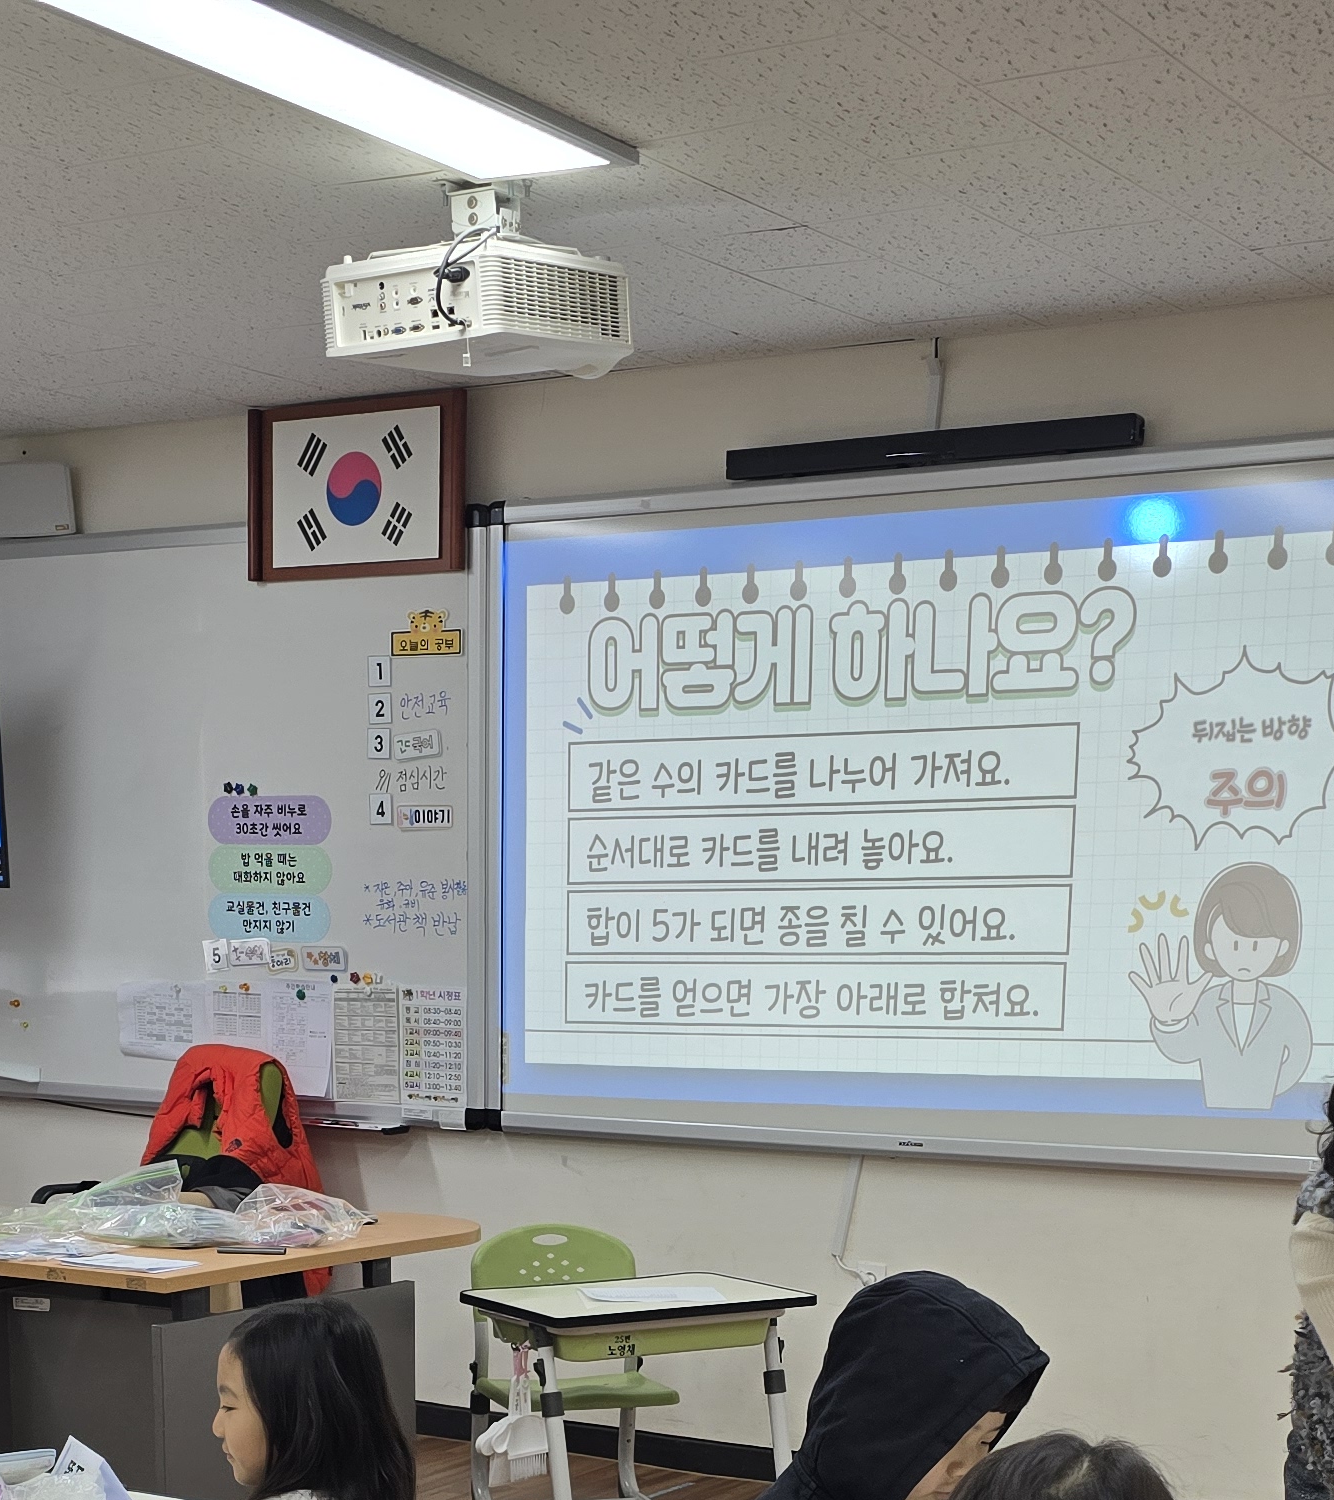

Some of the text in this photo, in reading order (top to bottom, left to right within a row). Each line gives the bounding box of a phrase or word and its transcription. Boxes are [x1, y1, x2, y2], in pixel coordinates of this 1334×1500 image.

[399, 638, 454, 651] 오늘의 공부
[588, 586, 1137, 718] 어떻게 하나요?
[376, 663, 382, 680] 1
[375, 700, 385, 718] 2
[400, 691, 451, 720] 안전교육
[1192, 714, 1312, 743] 뒤집는 방향
[374, 735, 384, 752] 3
[396, 765, 447, 792] 점심시간
[588, 750, 1010, 803] 같은 수의 카드를 나누어 가져요.
[1204, 767, 1287, 818] 주의
[230, 804, 307, 818] 손을 자주 비누로
[376, 801, 385, 818] 4
[414, 808, 450, 824] 이야기
[235, 822, 302, 837] 30초간 씻어요
[587, 828, 953, 872] 순서대로 카드를 내려 놓아요.
[241, 852, 297, 867] 밥 먹을 때는
[233, 871, 306, 886] 대화하지 않아요
[226, 901, 311, 916] 교실물건, 친구물건
[242, 920, 295, 934] 만지지 않기
[413, 912, 427, 937] 책
[431, 911, 461, 936] 반납
[587, 903, 1015, 948] 합이 5가 되면 종을 칠 수 있어요.
[212, 947, 221, 963] 5
[415, 990, 461, 1001] 1학년 시정표
[584, 976, 1038, 1020] 카드를 얻으면 가장 아래로 합쳐요.
